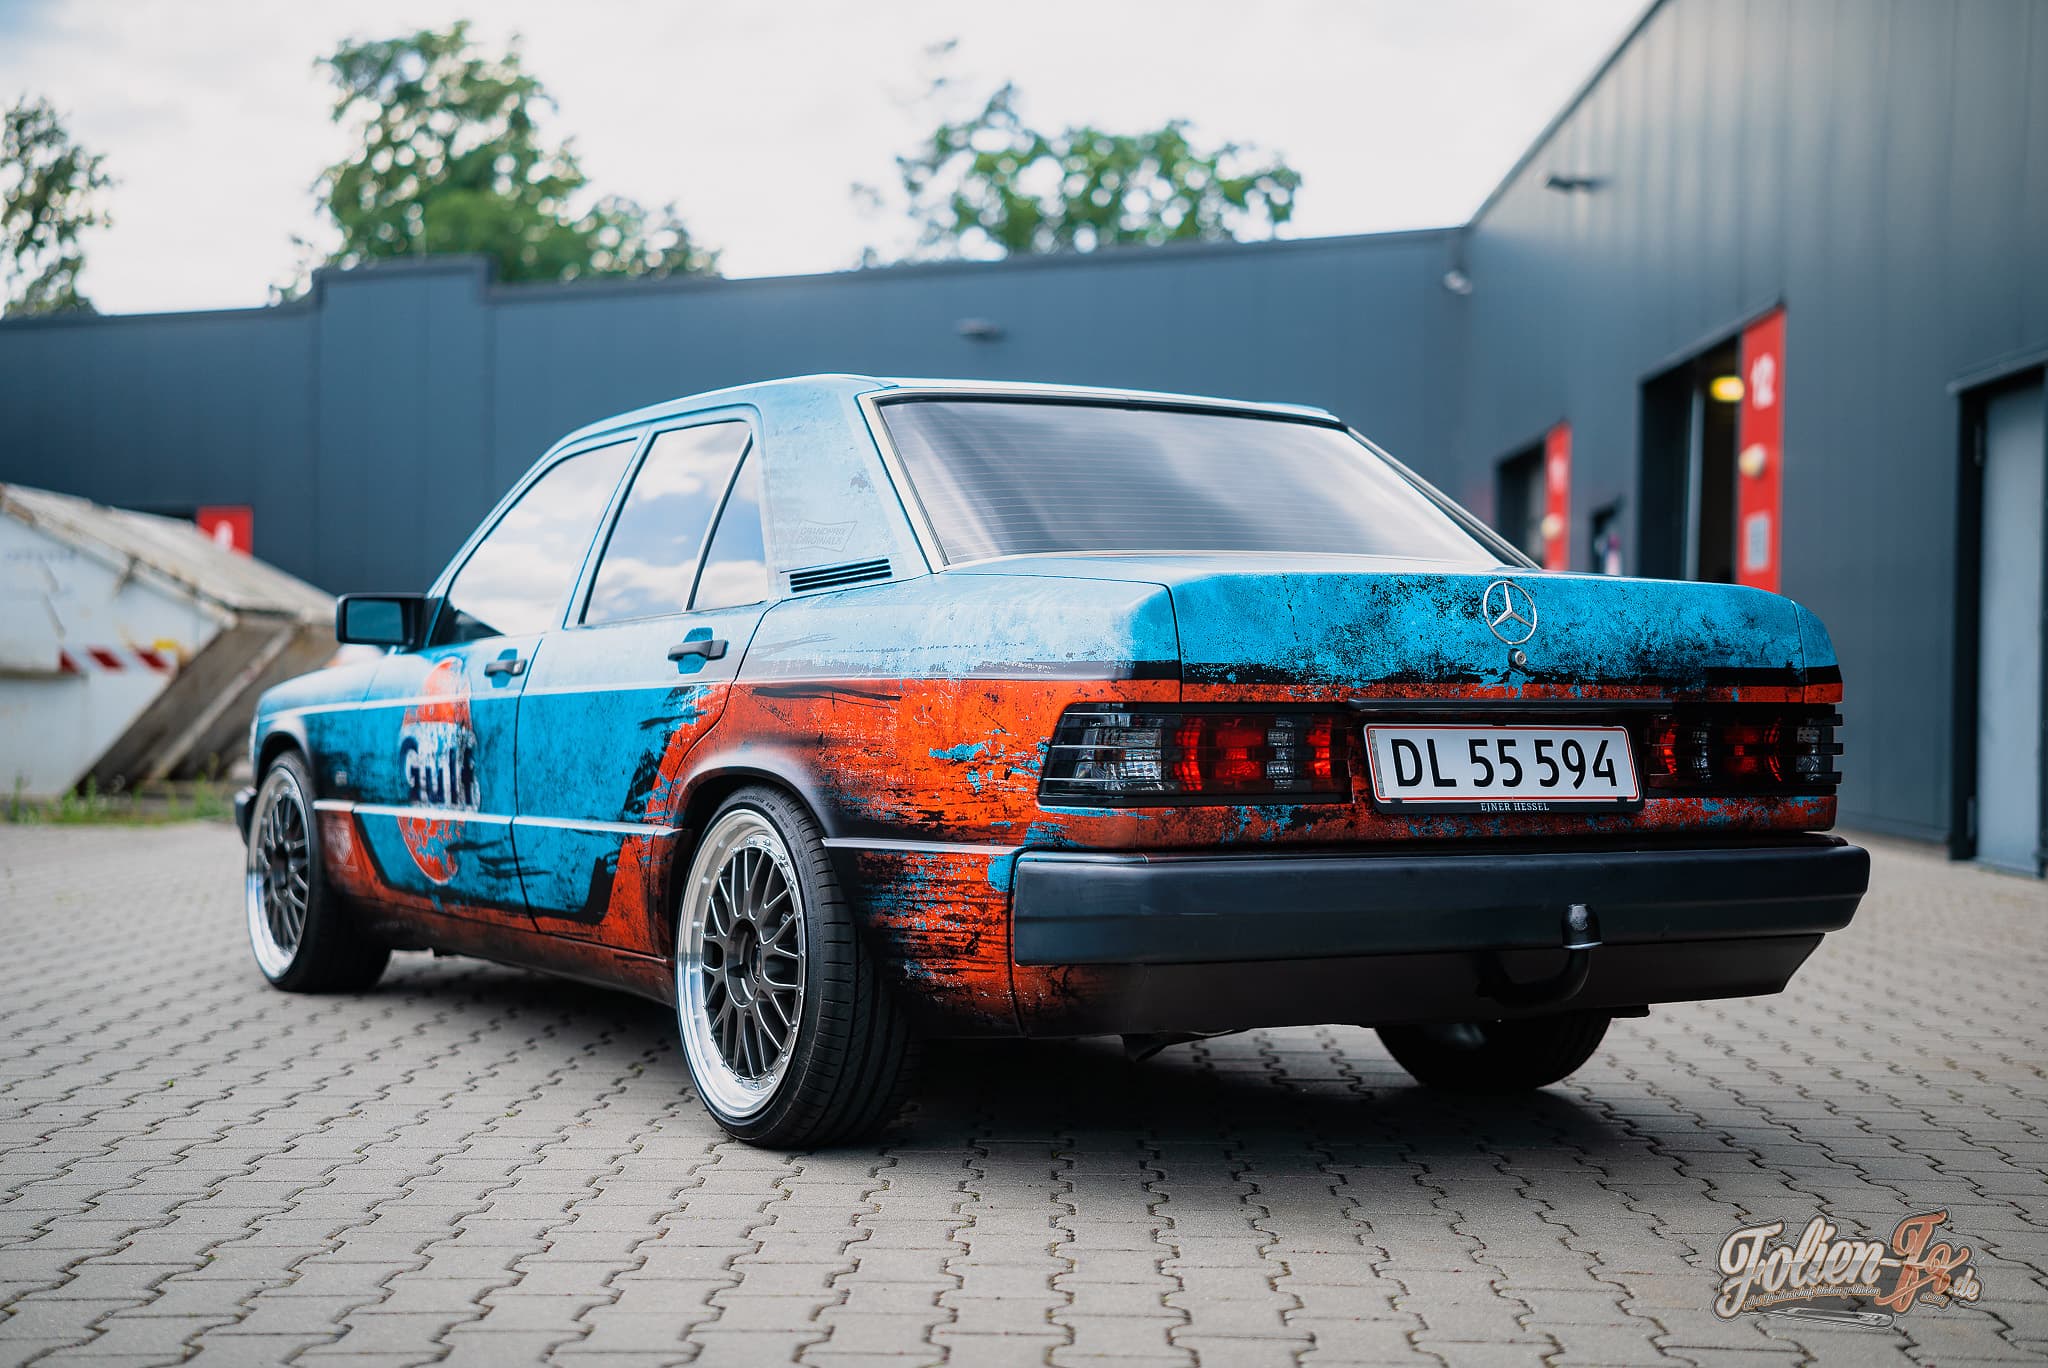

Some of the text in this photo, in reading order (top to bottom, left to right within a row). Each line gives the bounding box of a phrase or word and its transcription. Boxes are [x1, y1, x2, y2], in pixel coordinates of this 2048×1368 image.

[1390, 738, 1618, 790] DL 55 594
[1481, 802, 1550, 812] EJNER HESSEL
